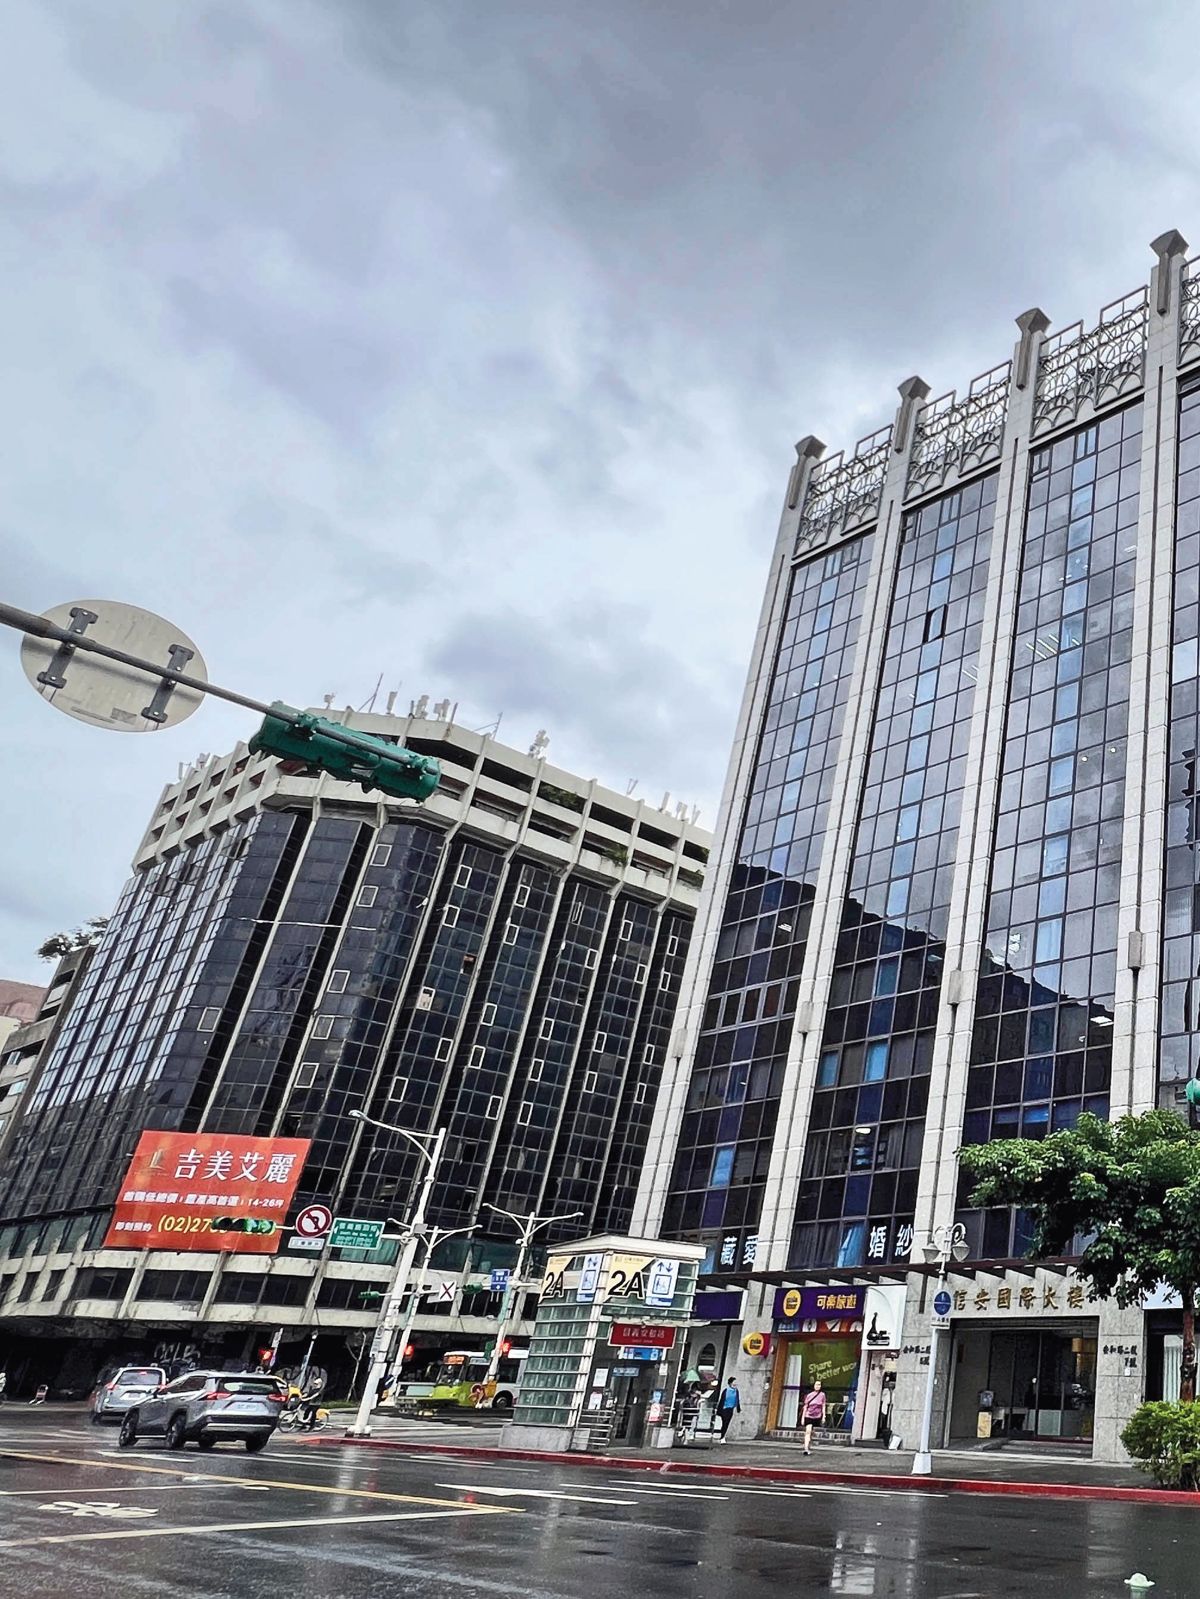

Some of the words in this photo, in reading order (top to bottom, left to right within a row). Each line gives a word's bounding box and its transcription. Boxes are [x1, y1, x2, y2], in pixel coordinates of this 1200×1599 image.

[174, 1149, 297, 1183] 吉美艾麗
[868, 1224, 914, 1258] 婚紗
[542, 1270, 564, 1298] 2A
[607, 1269, 645, 1299] 2A
[817, 1294, 857, 1309] 可樂旅遊
[954, 1285, 1085, 1310] 信安國際大樓
[808, 1360, 832, 1374] Share
[815, 1367, 841, 1381] better
